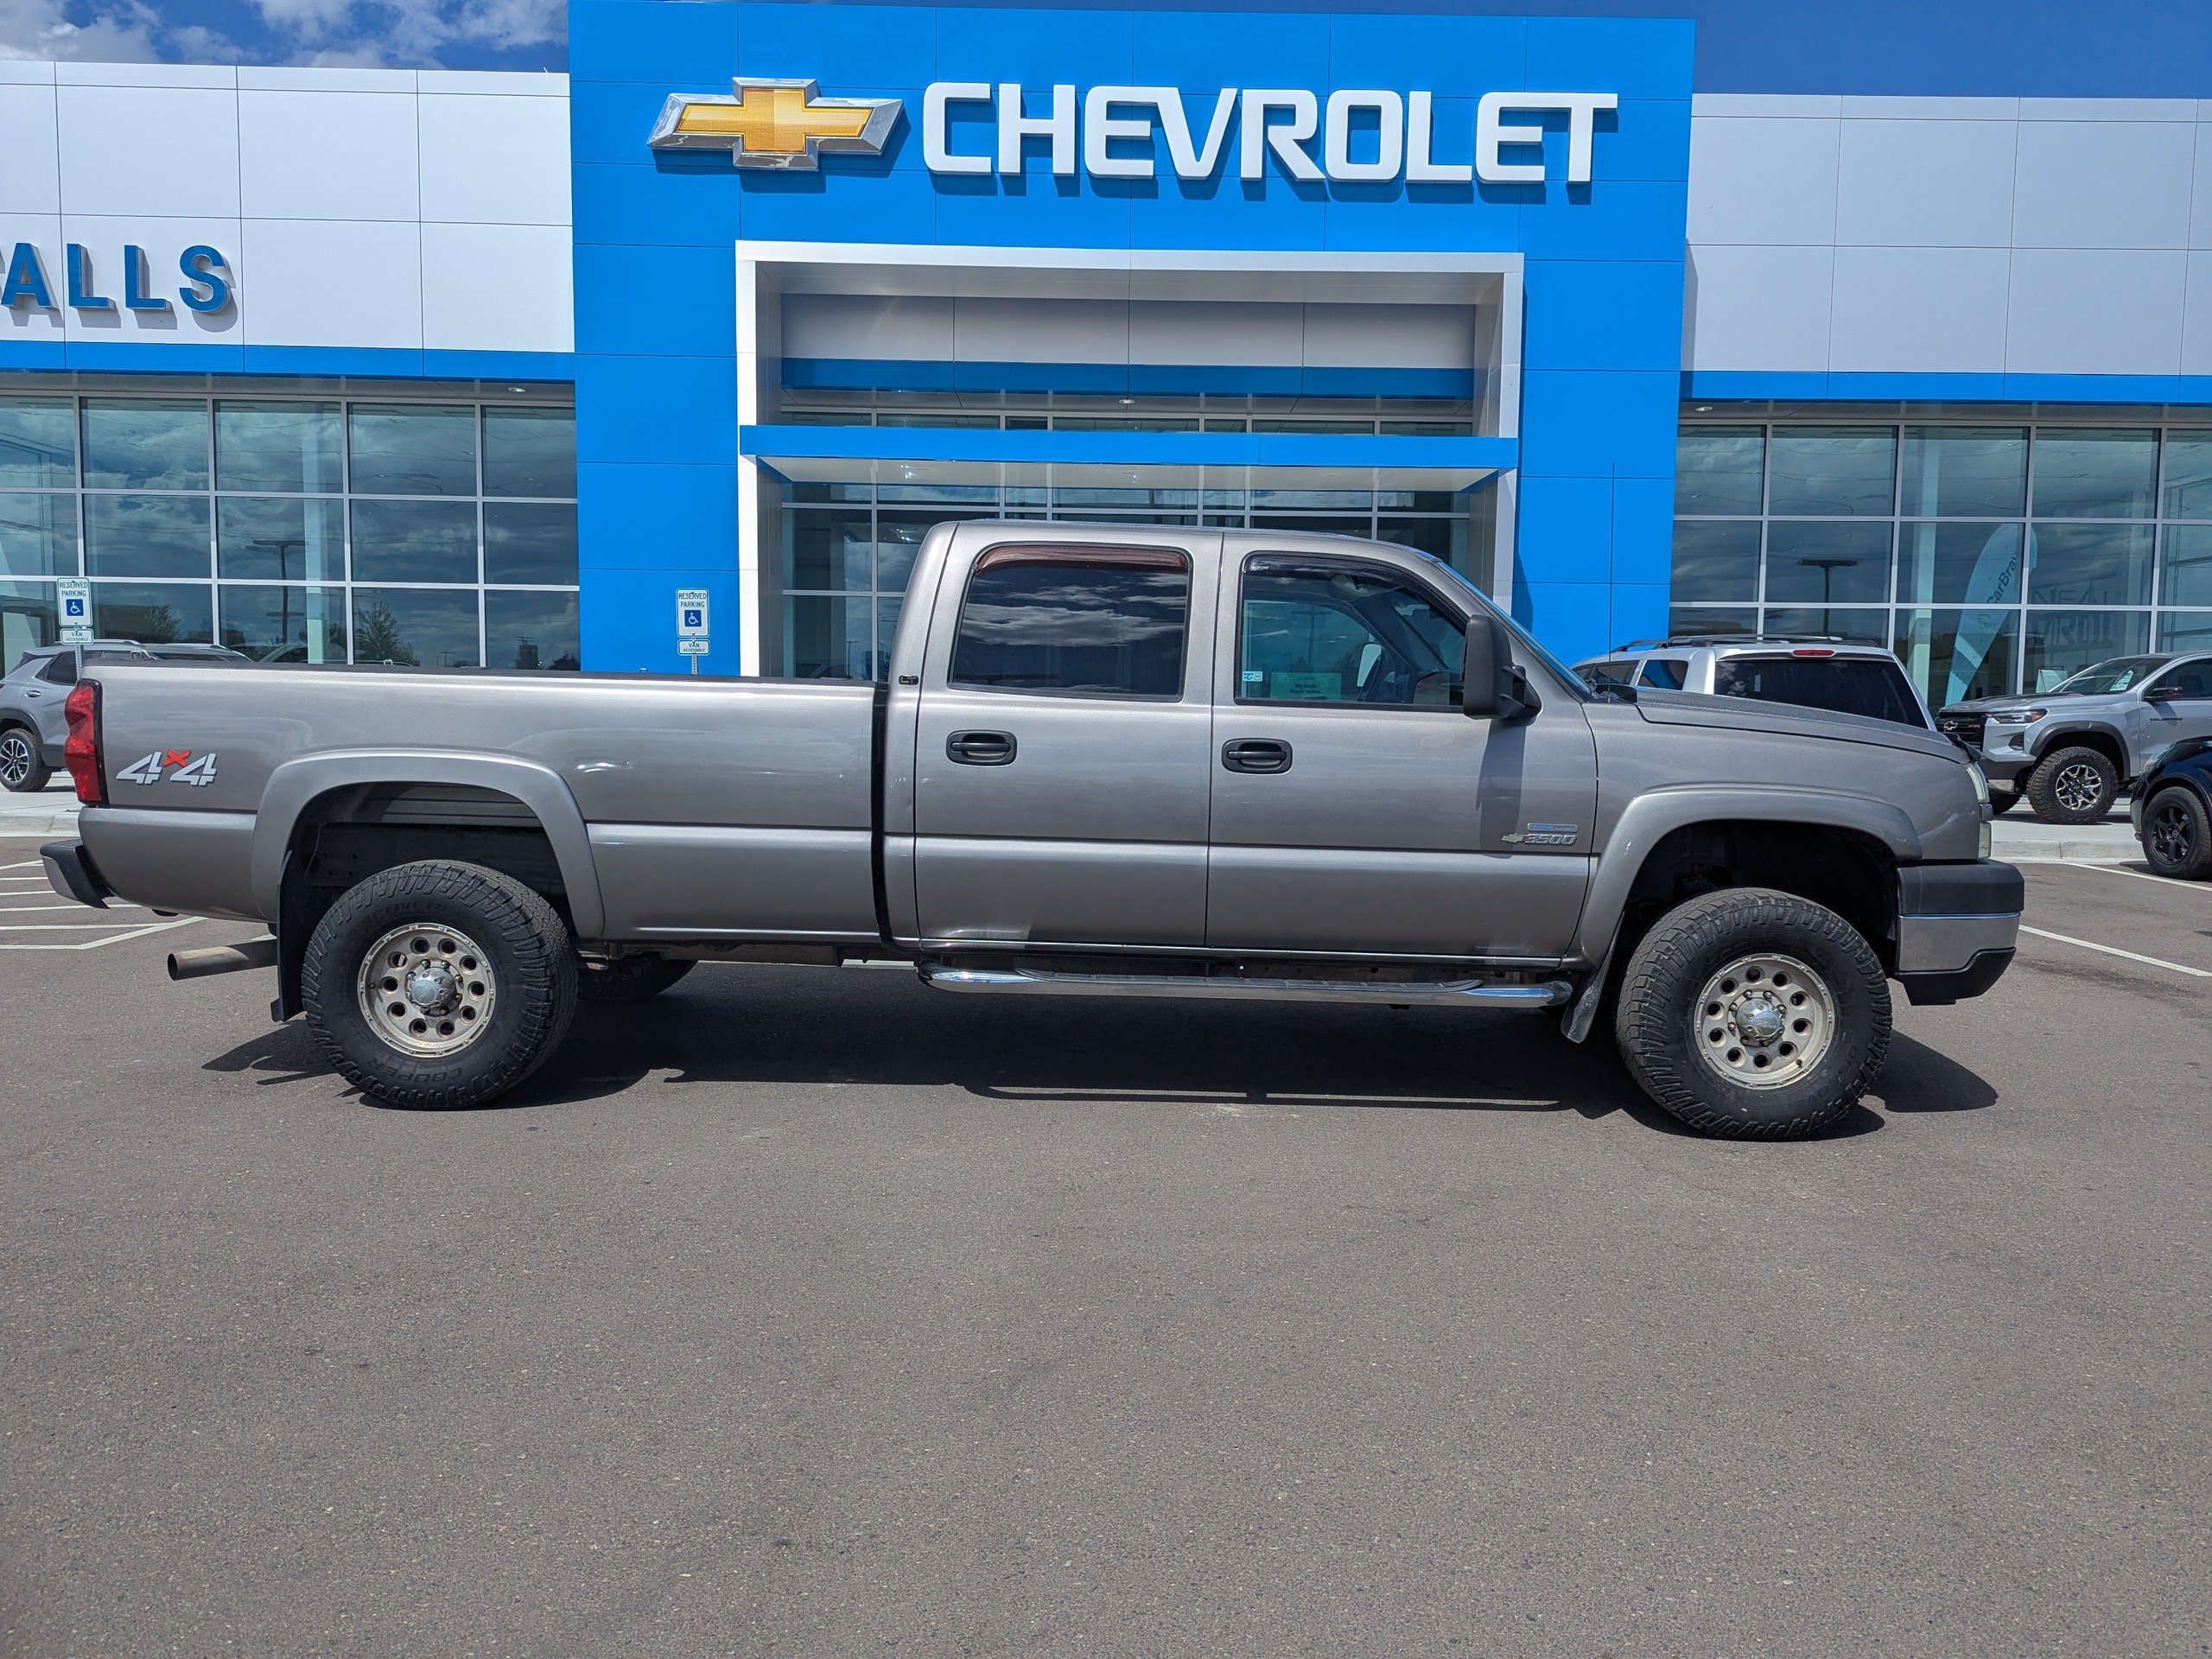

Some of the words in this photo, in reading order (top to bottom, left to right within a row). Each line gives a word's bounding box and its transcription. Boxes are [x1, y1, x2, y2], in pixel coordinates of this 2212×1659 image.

[923, 82, 1618, 182] CHEVROLET
[0, 242, 230, 313] ALLS
[1523, 833, 1578, 845] 3500
